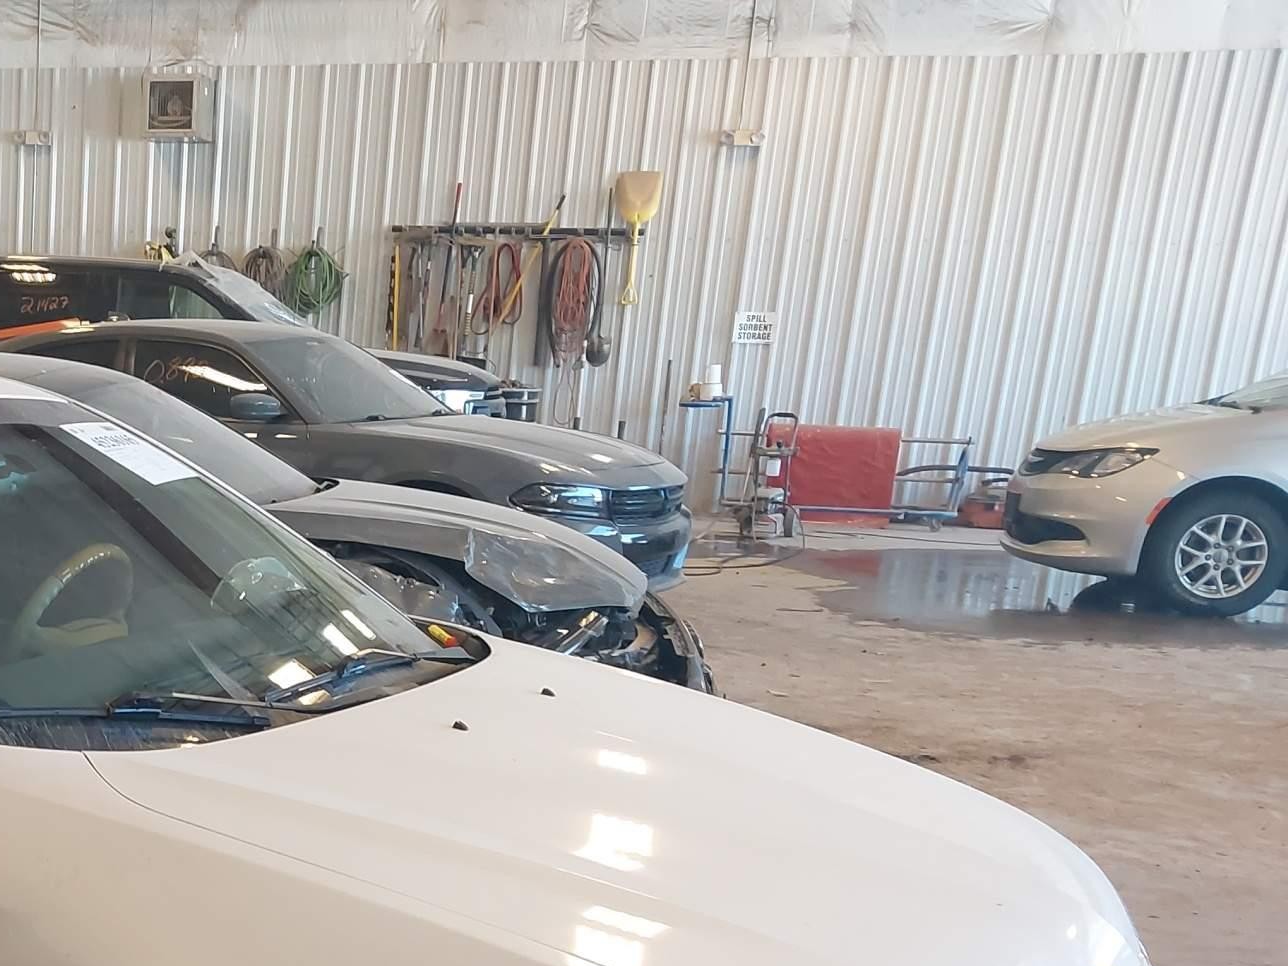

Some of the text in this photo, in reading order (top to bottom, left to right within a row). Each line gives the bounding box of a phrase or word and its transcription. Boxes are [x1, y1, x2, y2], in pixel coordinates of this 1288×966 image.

[745, 314, 768, 323] SPILL
[738, 322, 773, 332] SORBENT
[737, 331, 772, 341] STORAGE
